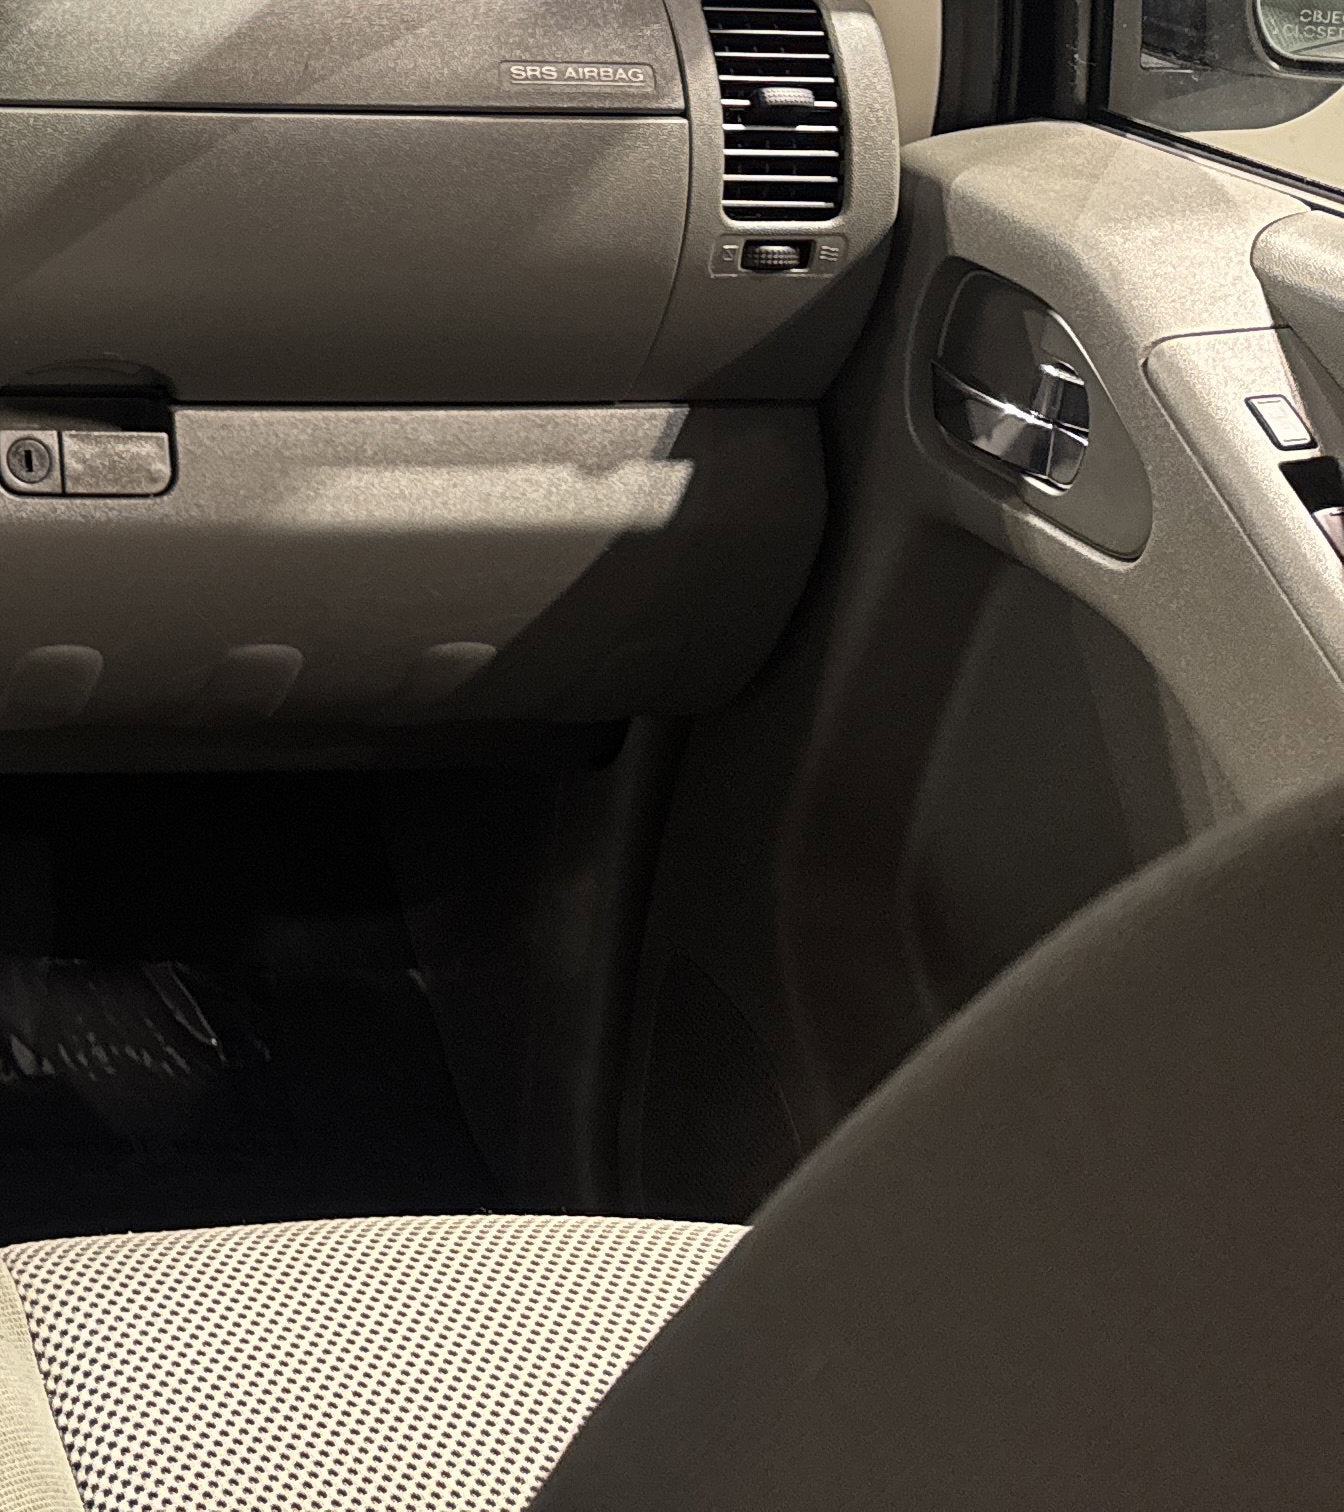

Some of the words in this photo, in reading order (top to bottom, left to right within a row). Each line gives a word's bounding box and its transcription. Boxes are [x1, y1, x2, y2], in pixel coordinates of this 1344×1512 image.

[1299, 9, 1344, 24] OBJE
[509, 65, 558, 81] SRS
[563, 67, 645, 82] AIRBAG
